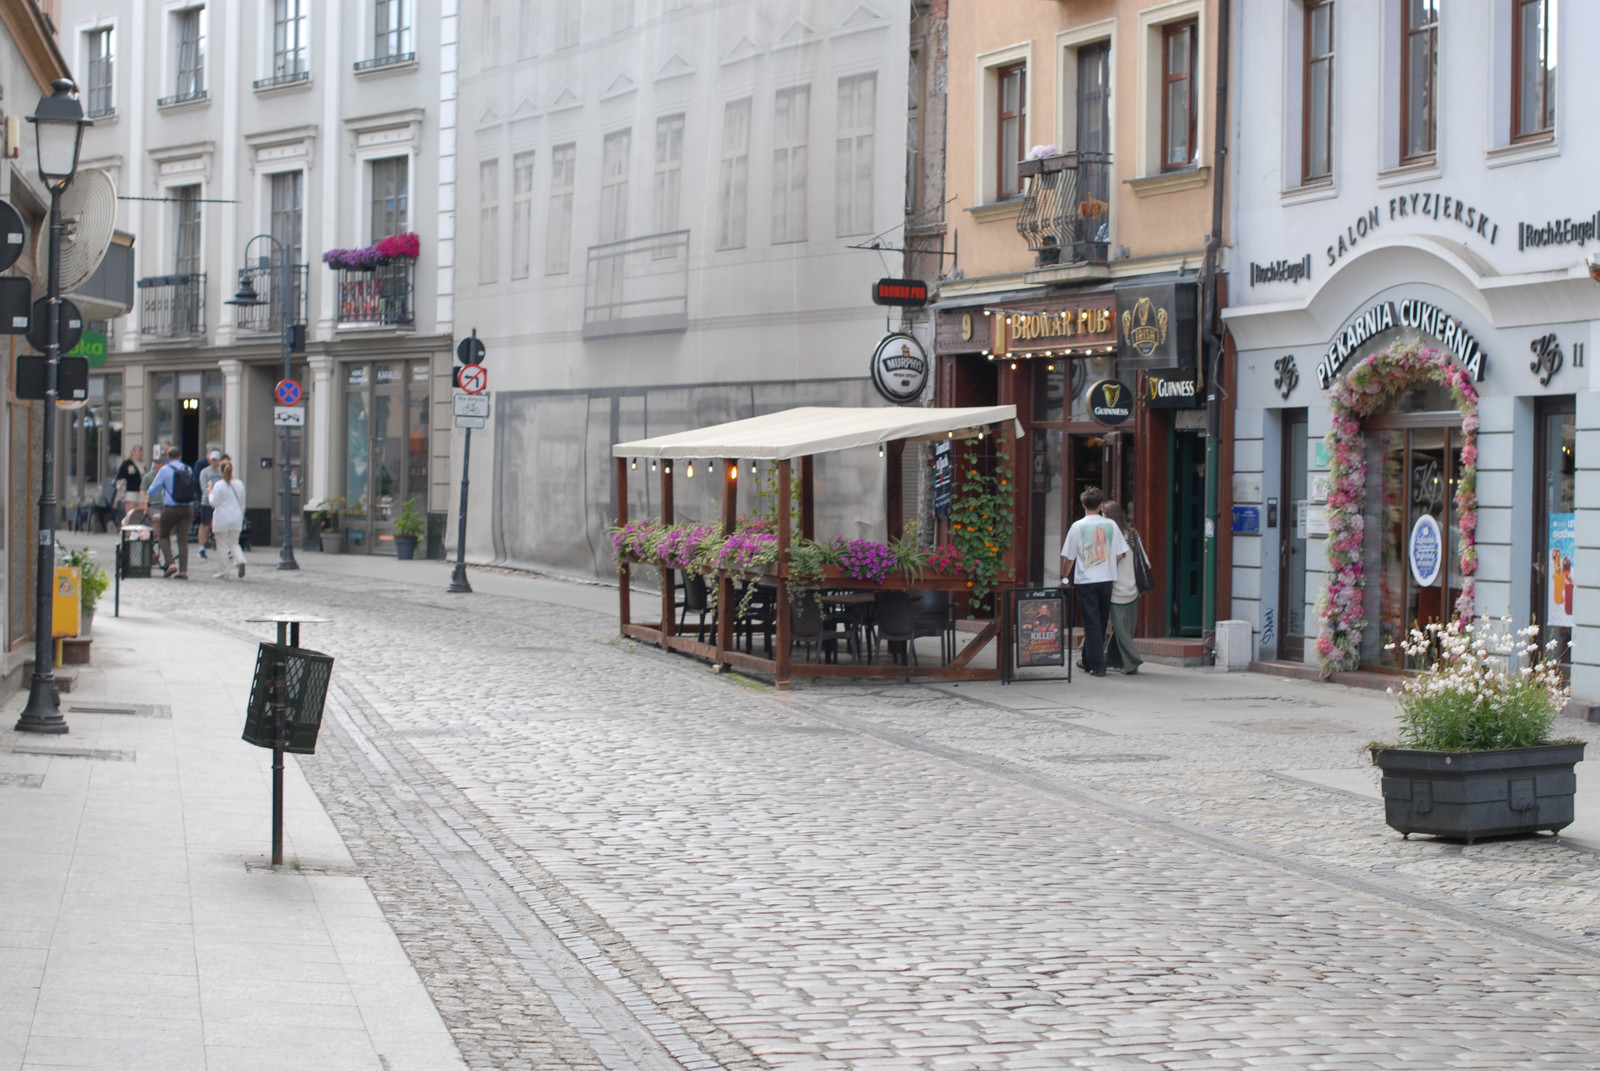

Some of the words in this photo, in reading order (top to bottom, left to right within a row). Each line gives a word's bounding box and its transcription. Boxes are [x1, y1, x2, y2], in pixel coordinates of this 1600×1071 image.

[1326, 205, 1380, 267] SALON
[1389, 192, 1499, 246] FRYZJERSKI
[1525, 213, 1596, 247] Roch&Engel
[961, 313, 973, 341] 9
[1011, 310, 1074, 340] BROWAR
[1077, 307, 1110, 335] PUB
[1135, 328, 1156, 342] IRISH
[1316, 301, 1397, 390] PIEKARNIA
[1400, 299, 1487, 382] CUKIERNIA
[1572, 342, 1585, 368] 11
[1157, 378, 1195, 398] GUINNESS
[1093, 406, 1130, 417] GUINNESS
